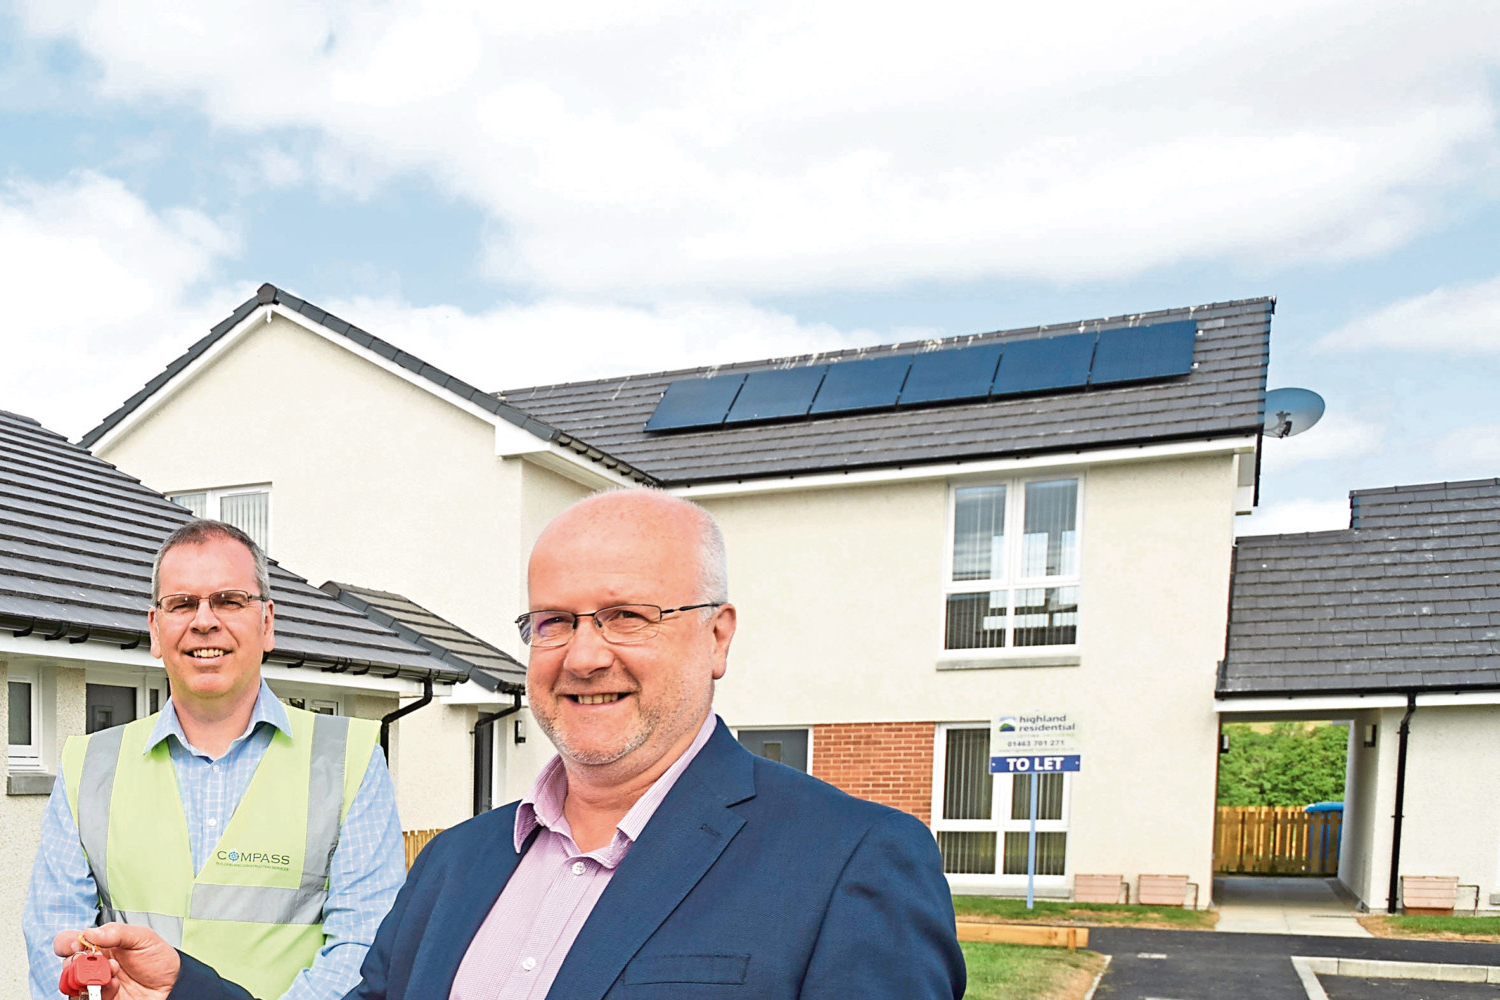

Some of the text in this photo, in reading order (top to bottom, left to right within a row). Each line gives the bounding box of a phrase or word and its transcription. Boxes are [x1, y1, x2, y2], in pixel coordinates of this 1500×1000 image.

[1019, 715, 1066, 724] highland
[1019, 723, 1075, 732] residential
[1006, 757, 1064, 771] TO LET
[217, 850, 290, 865] COMPASS
